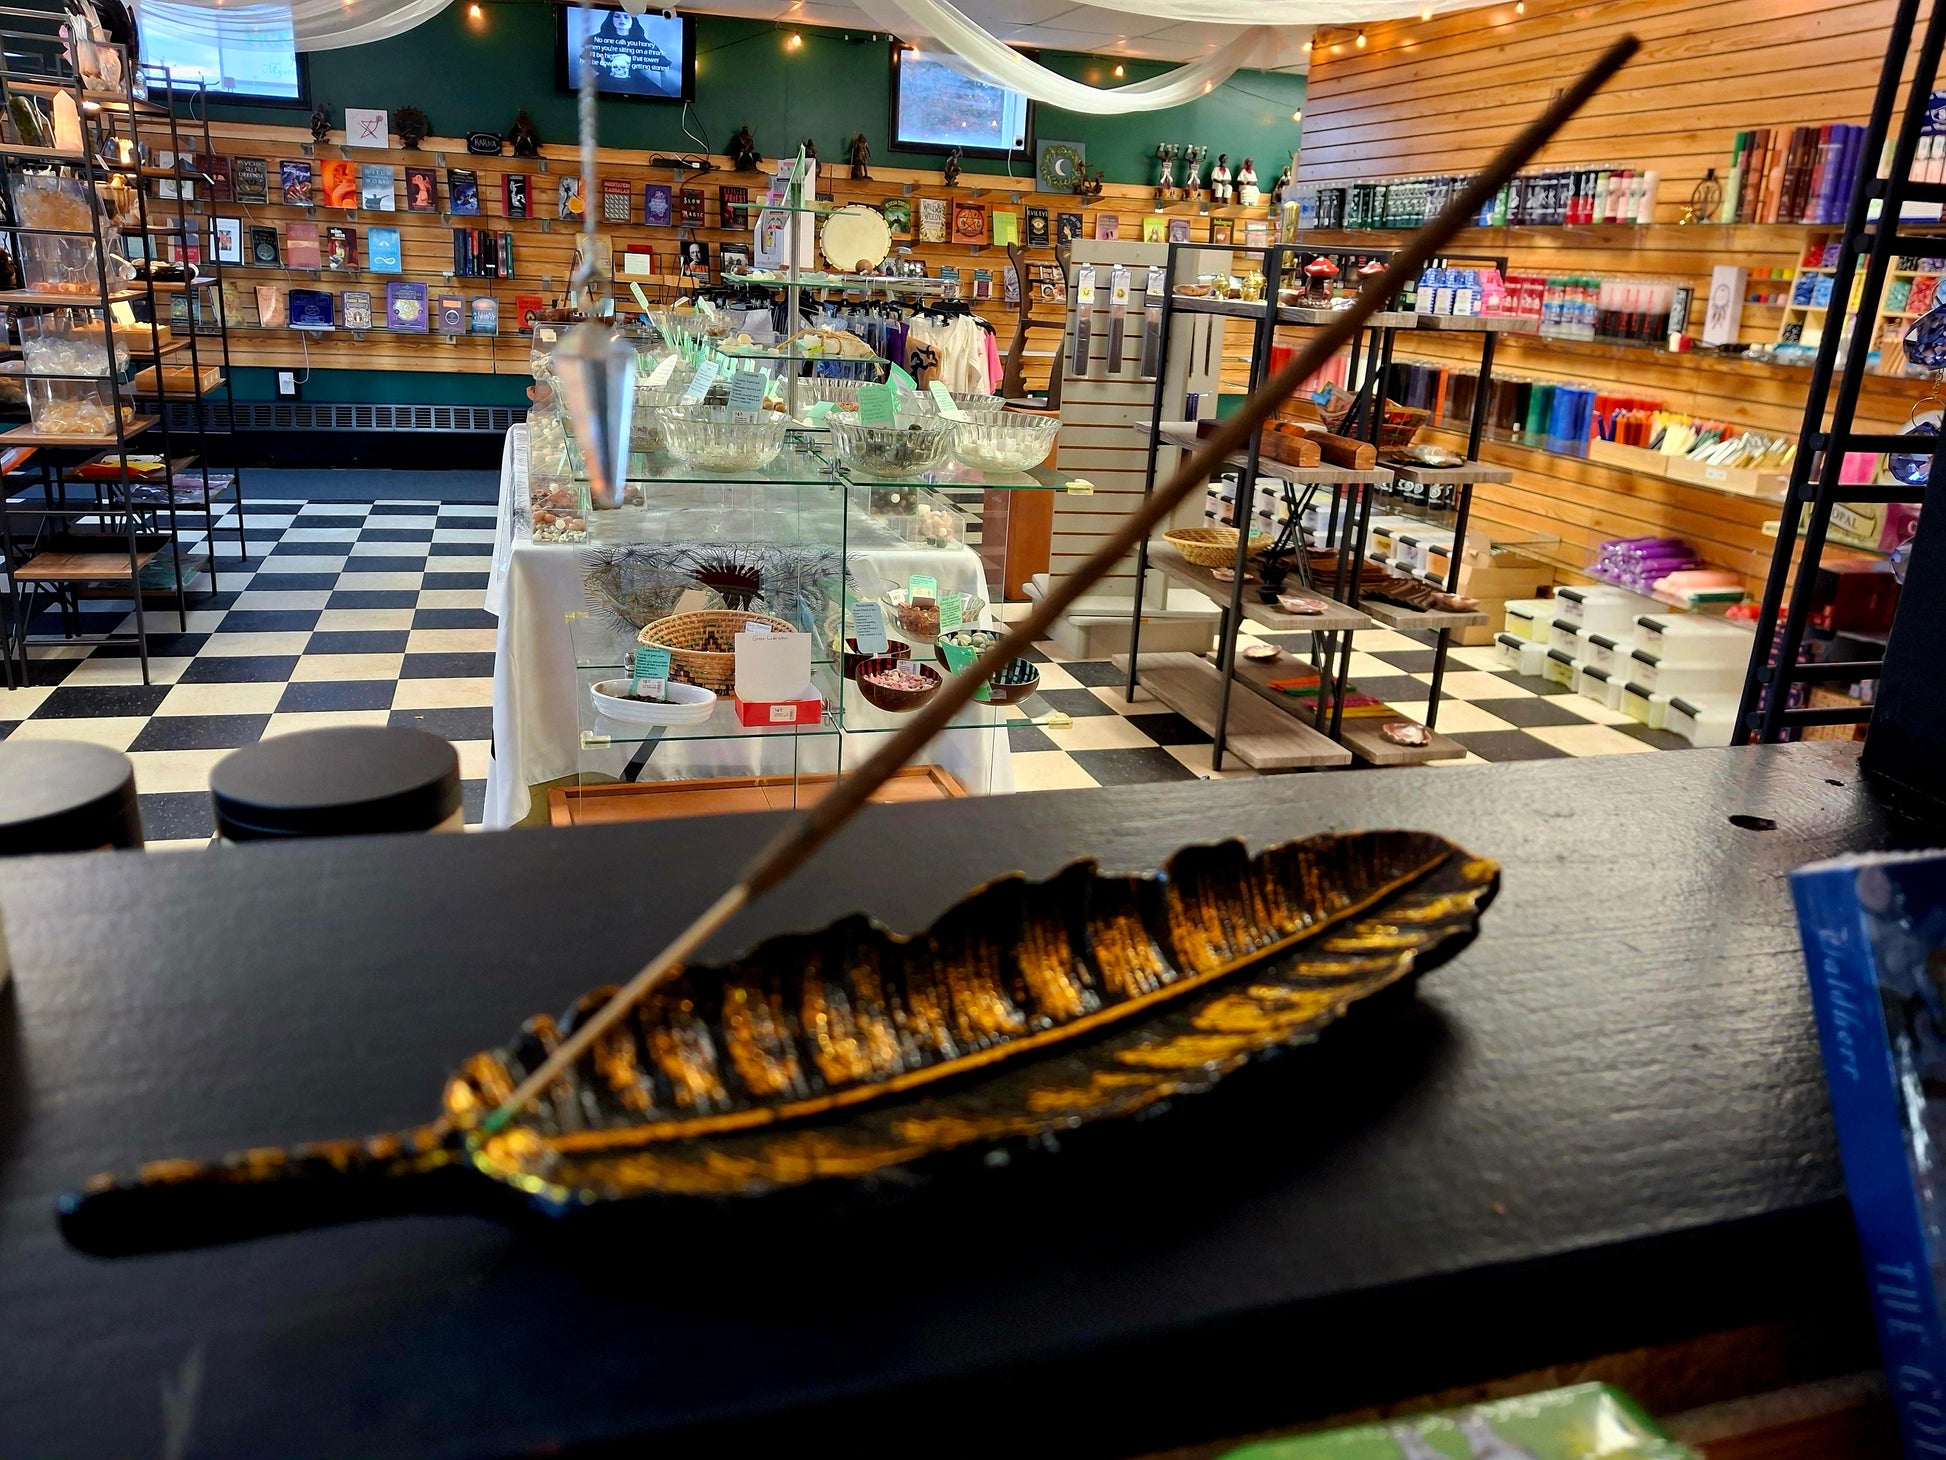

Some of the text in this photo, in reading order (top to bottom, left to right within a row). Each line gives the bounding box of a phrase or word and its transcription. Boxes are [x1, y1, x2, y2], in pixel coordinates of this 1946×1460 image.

[638, 41, 655, 49] honey
[619, 46, 635, 54] sitting
[631, 63, 651, 71] getting
[474, 138, 497, 148] KARMA
[683, 196, 701, 205] SLOW
[724, 193, 746, 204] PRIEST
[681, 210, 704, 218] MAGIC
[1028, 209, 1038, 217] EVIL
[1832, 507, 1858, 531] OPAL
[1875, 1261, 1923, 1345] THE
